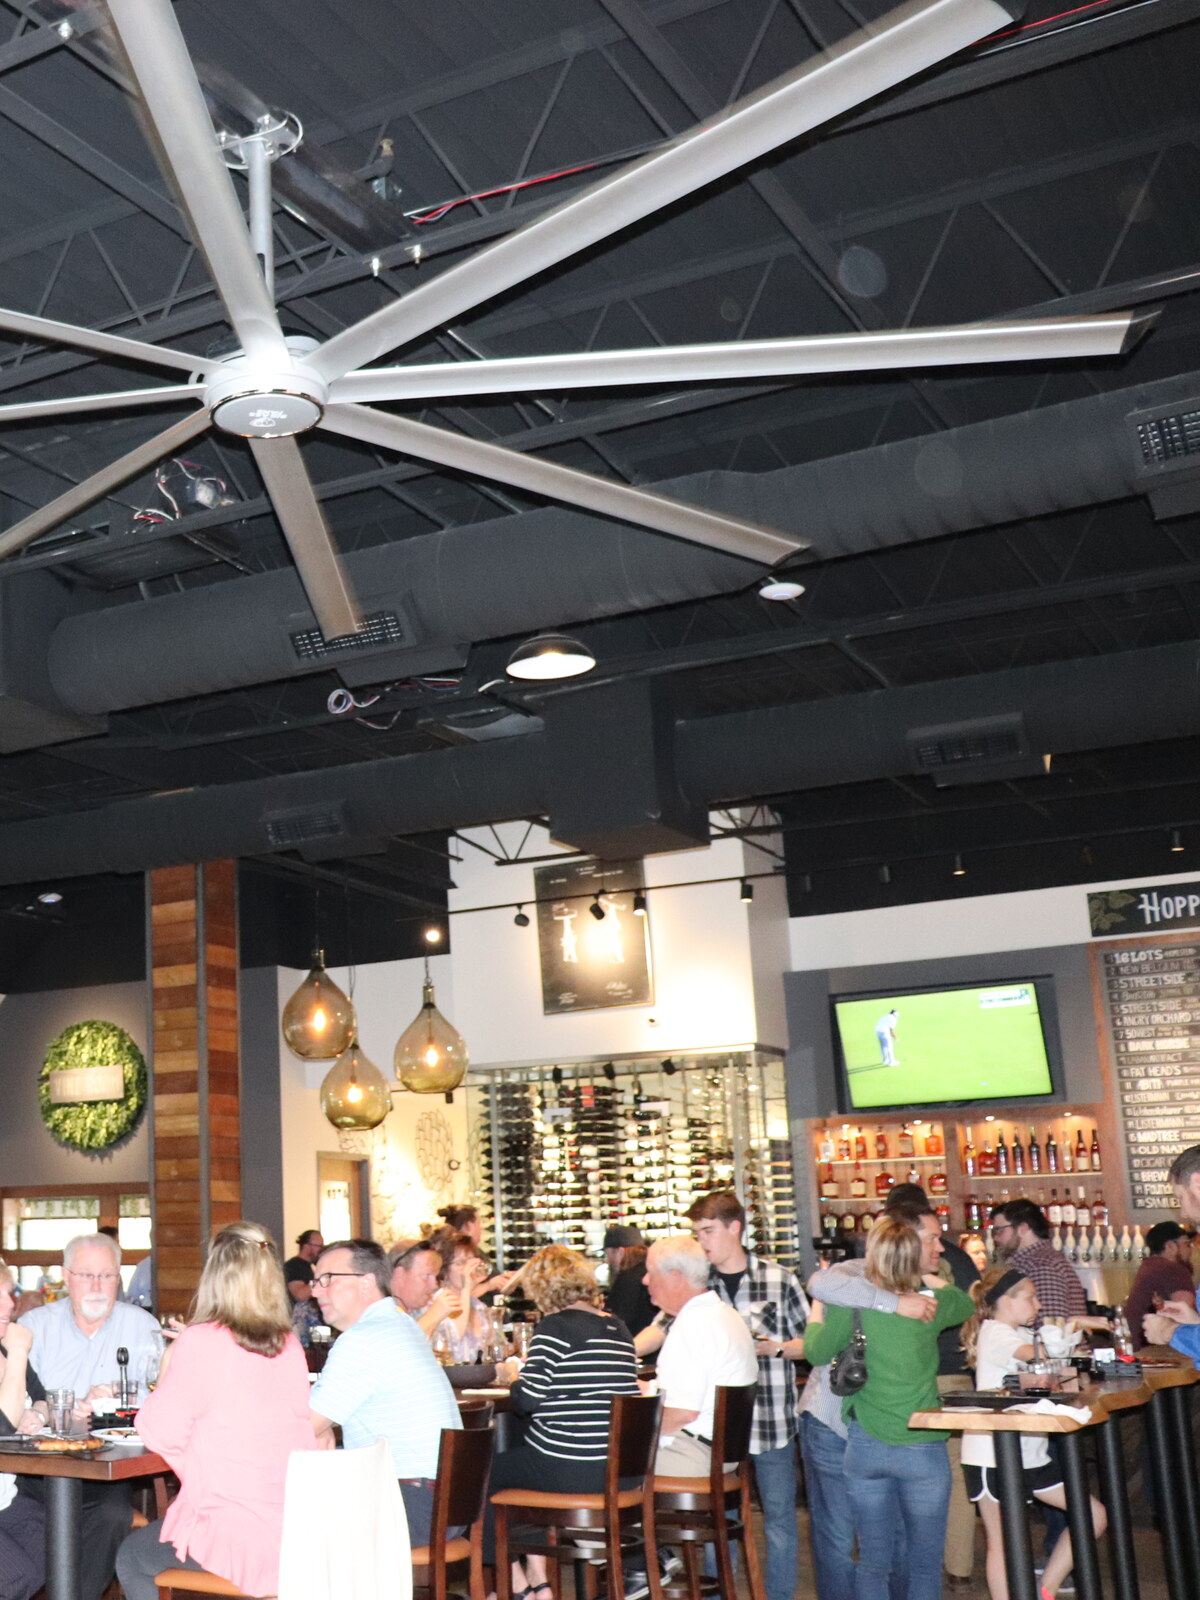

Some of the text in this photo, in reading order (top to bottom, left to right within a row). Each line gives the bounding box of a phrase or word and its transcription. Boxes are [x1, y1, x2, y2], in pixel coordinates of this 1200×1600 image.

[1130, 949, 1164, 963] LOTS
[1120, 964, 1140, 975] NEW
[1141, 961, 1180, 974] BELGIUM
[1123, 1014, 1149, 1026] ANGRY
[1150, 1012, 1192, 1025] ORCHARD
[1130, 1067, 1146, 1078] FAT
[1137, 1130, 1180, 1143] MADTREE
[1138, 1146, 1160, 1155] OLD
[1141, 1156, 1166, 1168] CIGAR
